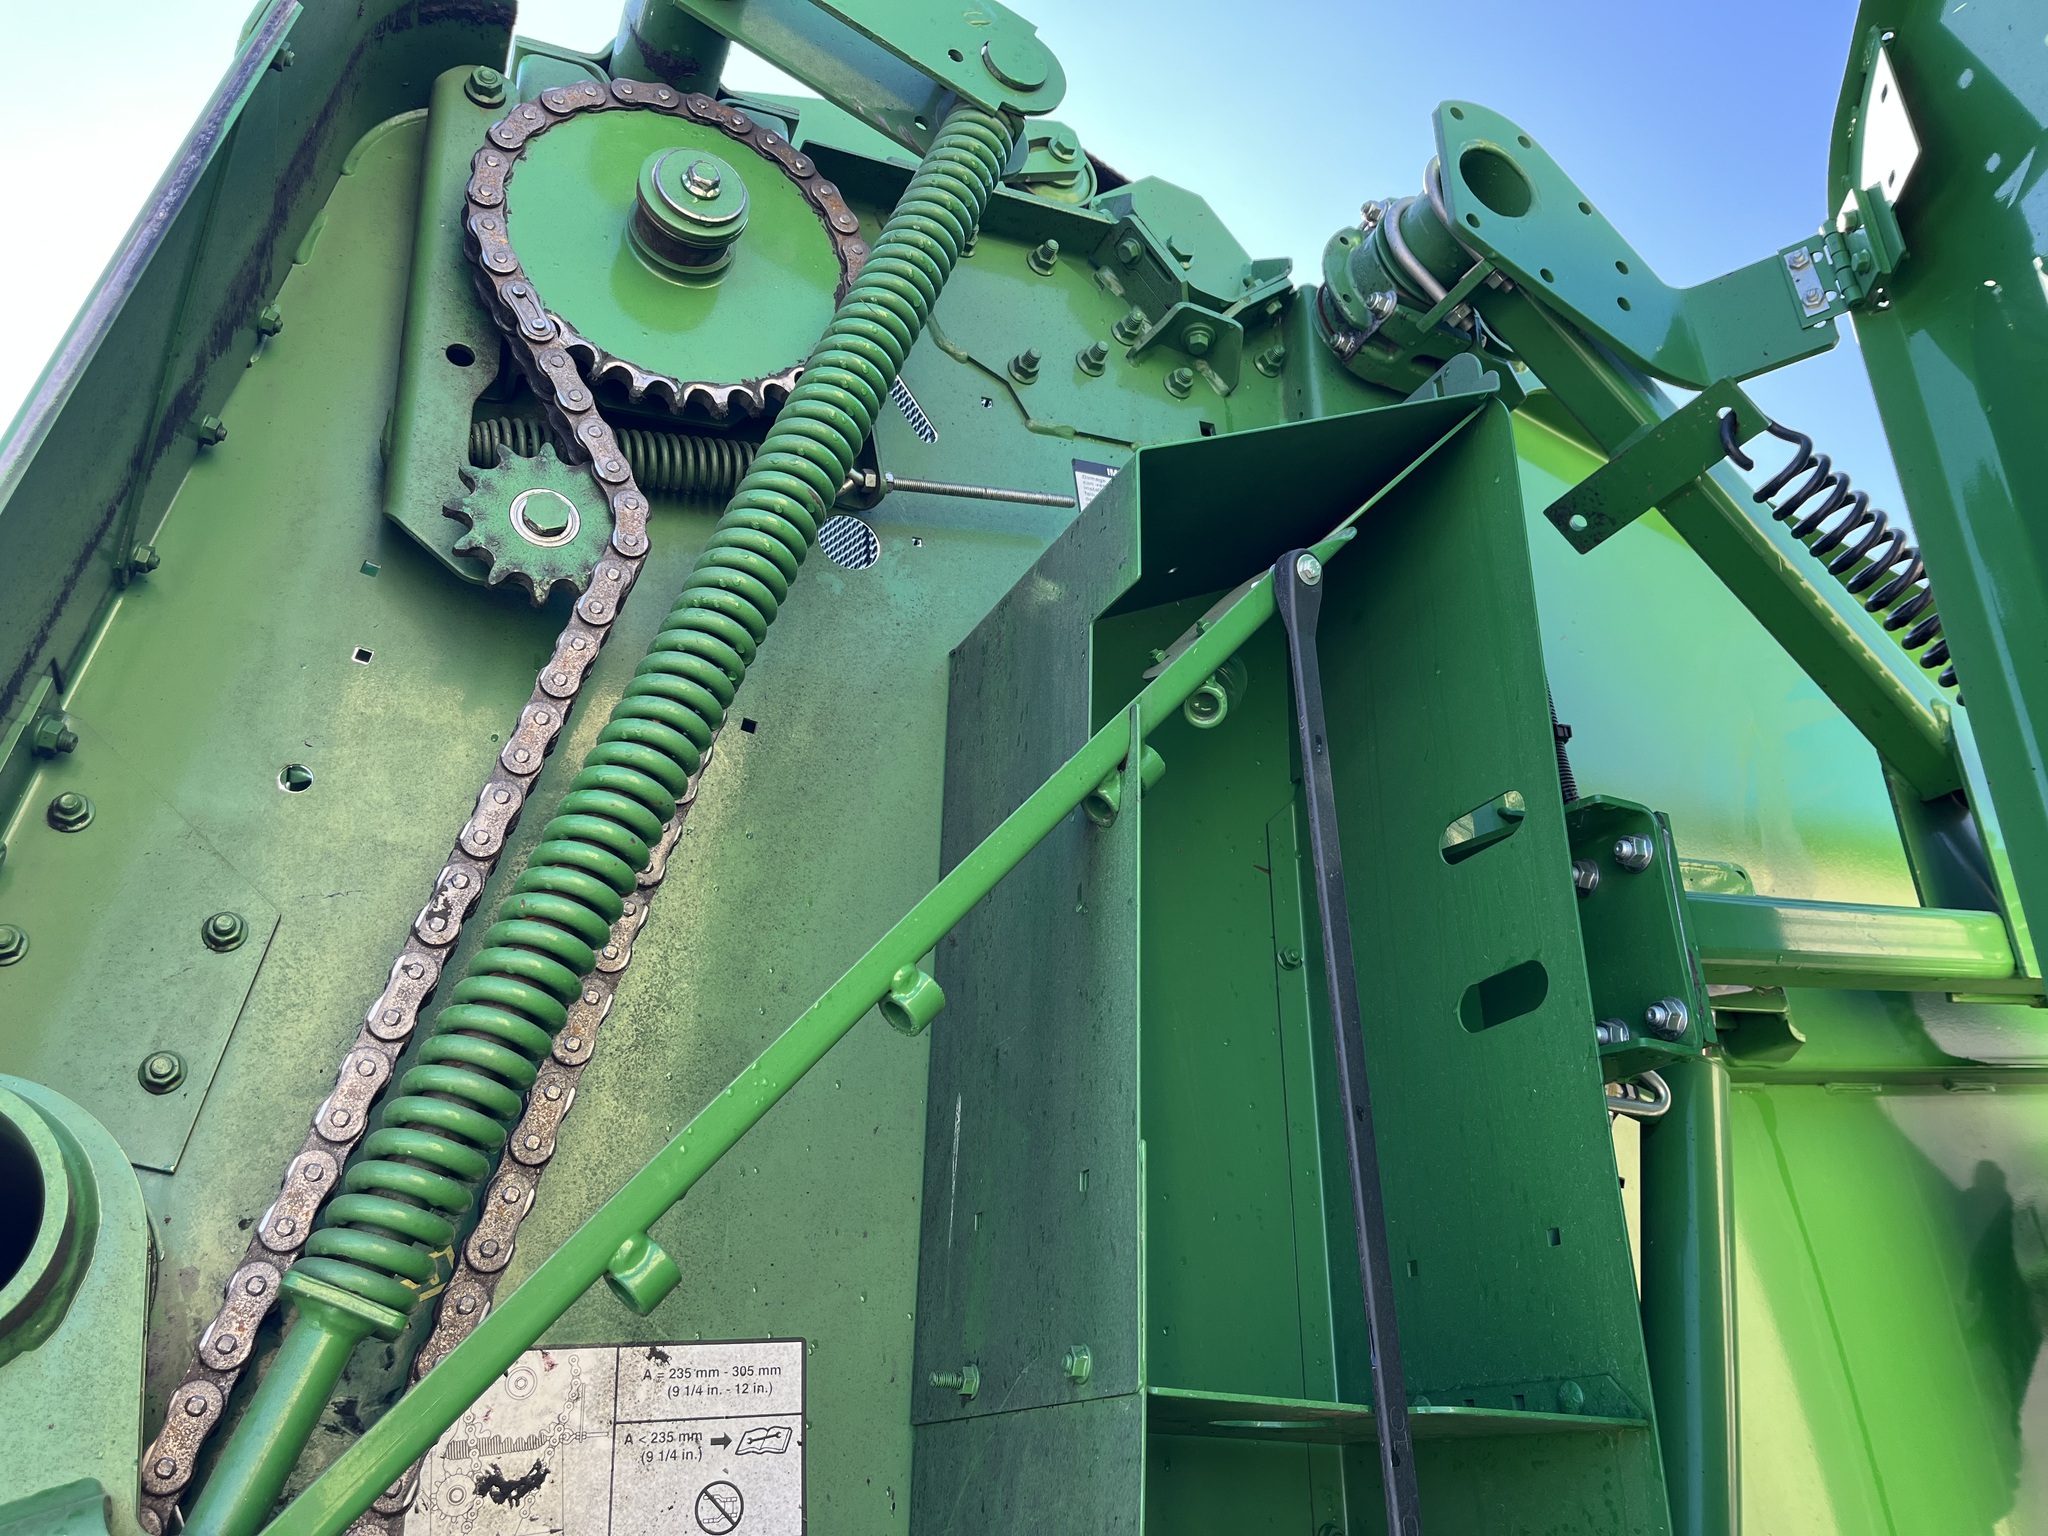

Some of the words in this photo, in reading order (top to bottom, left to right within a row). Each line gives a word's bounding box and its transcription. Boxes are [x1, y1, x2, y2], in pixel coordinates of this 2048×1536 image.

[642, 1369, 652, 1380] A
[669, 1368, 692, 1379] 235
[696, 1369, 720, 1378] mm
[732, 1366, 754, 1377] 305
[758, 1366, 781, 1376] mm
[668, 1386, 680, 1400] (9
[685, 1385, 703, 1396] 1/4
[707, 1384, 722, 1395] in.
[735, 1383, 749, 1394] 12
[753, 1382, 773, 1397] in.)
[624, 1433, 633, 1445] A
[651, 1431, 674, 1443] 235
[679, 1432, 702, 1442] mm
[641, 1451, 653, 1465] (9
[659, 1449, 677, 1461] 1/4
[682, 1448, 702, 1462] in.)
